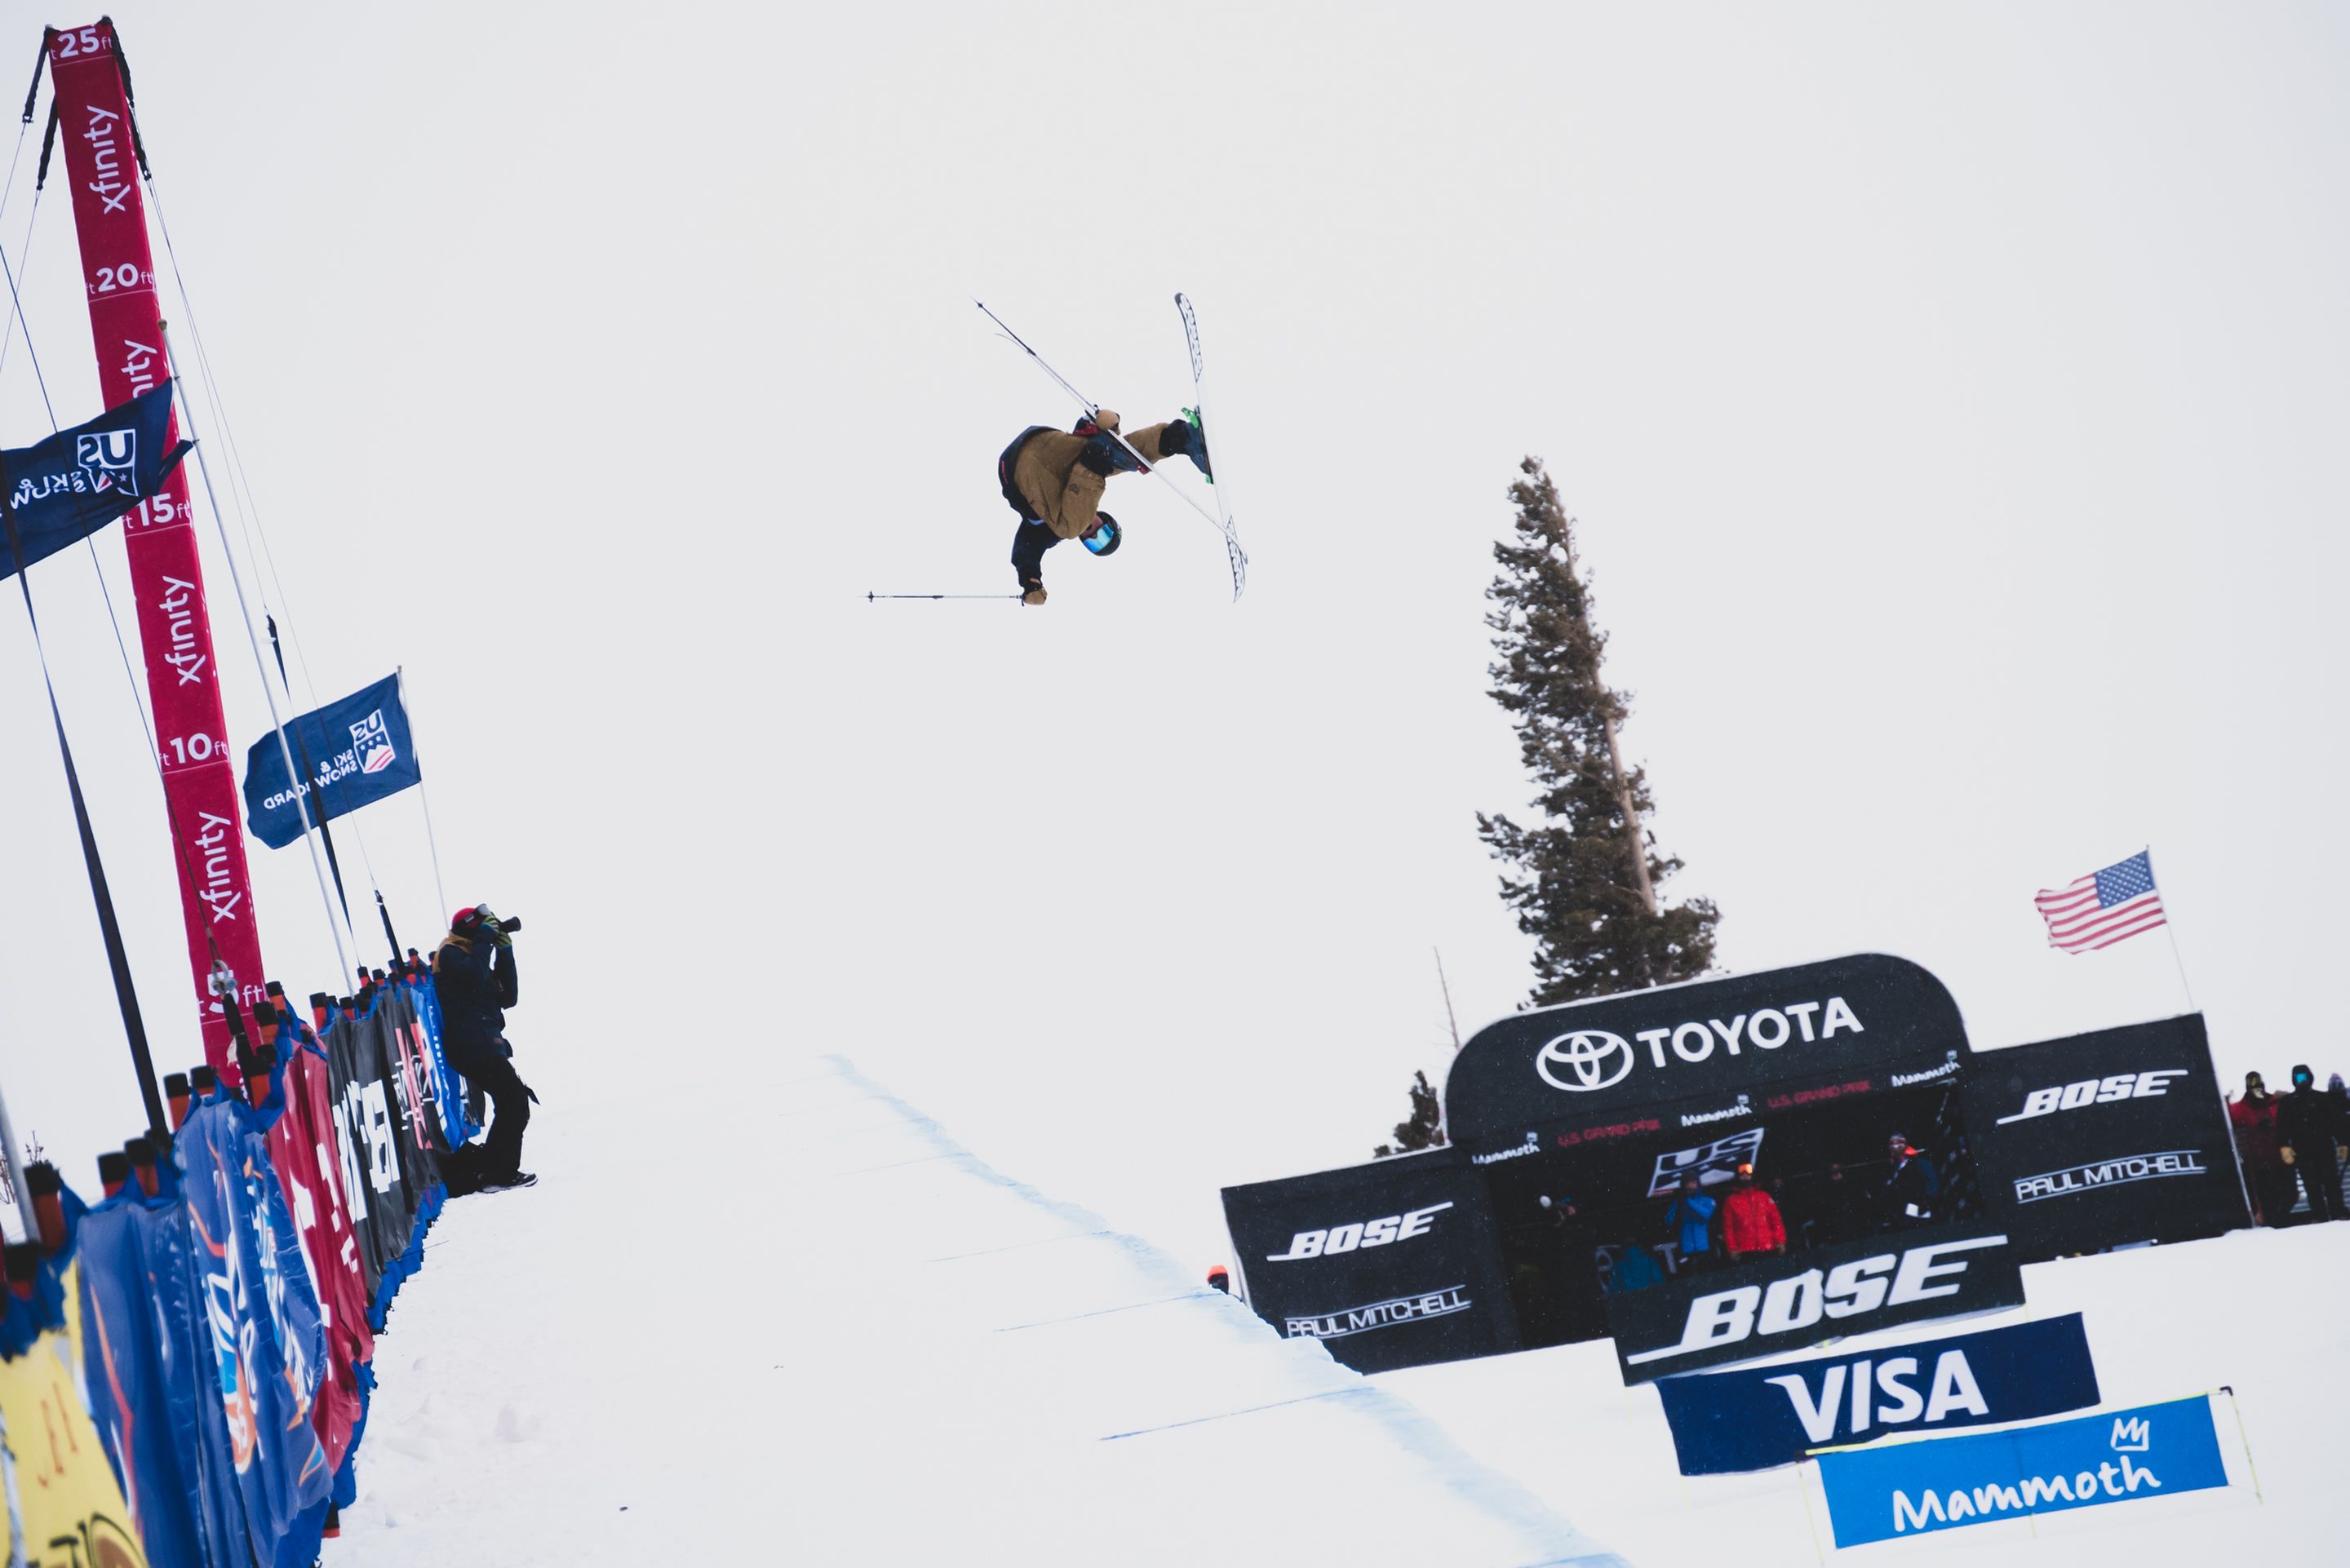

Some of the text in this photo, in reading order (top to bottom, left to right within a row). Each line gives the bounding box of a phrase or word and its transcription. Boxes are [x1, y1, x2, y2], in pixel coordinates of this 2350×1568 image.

[83, 104, 131, 214] xfinity
[121, 339, 157, 399] nity
[158, 575, 206, 687] xfinity
[194, 811, 241, 924] xfinity
[1636, 996, 1864, 1068] TOYOTA
[1794, 1086, 1841, 1105] GRAND
[1891, 1061, 1962, 1087] Mammoth
[1996, 1069, 2188, 1125] BOSE
[1583, 1123, 1631, 1141] GRAND
[1681, 1104, 1752, 1127] Mammoth
[1471, 1142, 1541, 1165] Mammoth
[1659, 1132, 1762, 1172] US
[2015, 1154, 2206, 1201] PAUL MITCHELL
[1266, 1201, 1454, 1261] BOSE
[1286, 1291, 1472, 1338] PAUL MITCHELL
[1626, 1234, 2008, 1366] BOSE
[1765, 1349, 1989, 1443] VISA
[1891, 1455, 2162, 1533] Mammoth
